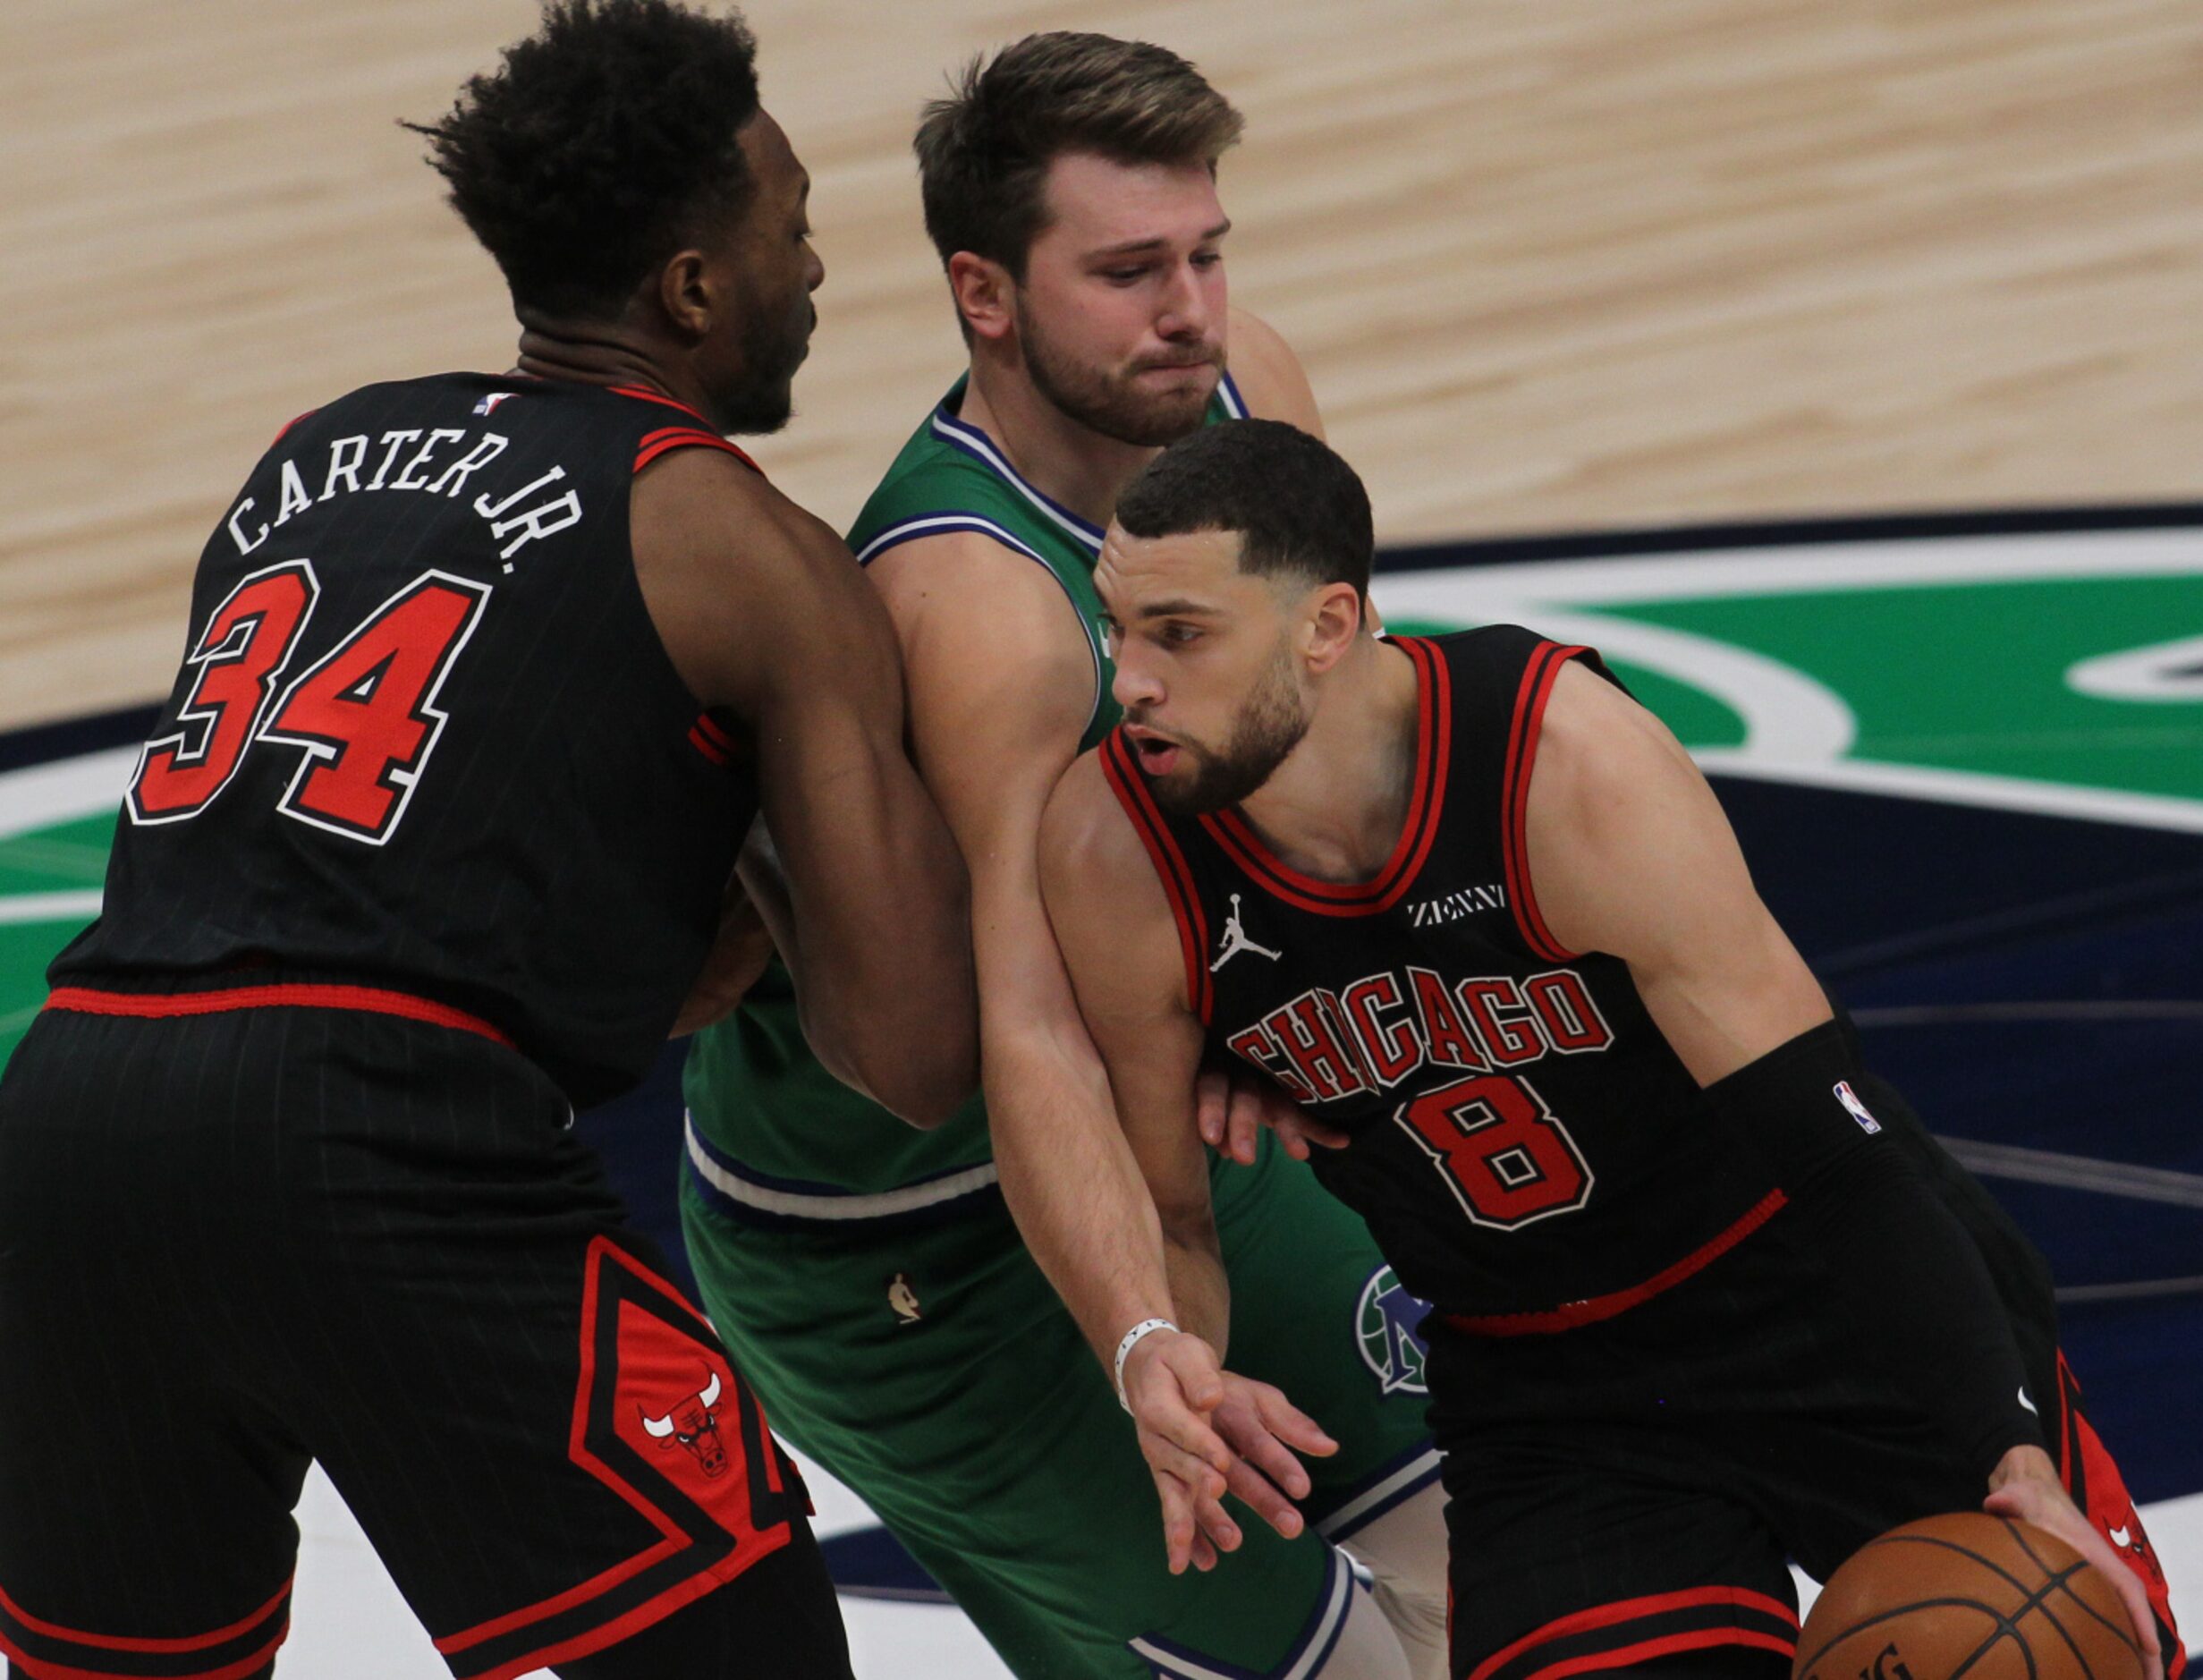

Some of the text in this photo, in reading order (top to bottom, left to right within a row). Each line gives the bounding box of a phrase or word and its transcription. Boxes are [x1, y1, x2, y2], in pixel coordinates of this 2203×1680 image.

[228, 428, 581, 574] CARTER JR.
[124, 558, 493, 846] 34
[1227, 965, 1614, 1103] CHICAGO
[1394, 1075, 1595, 1232] 8
